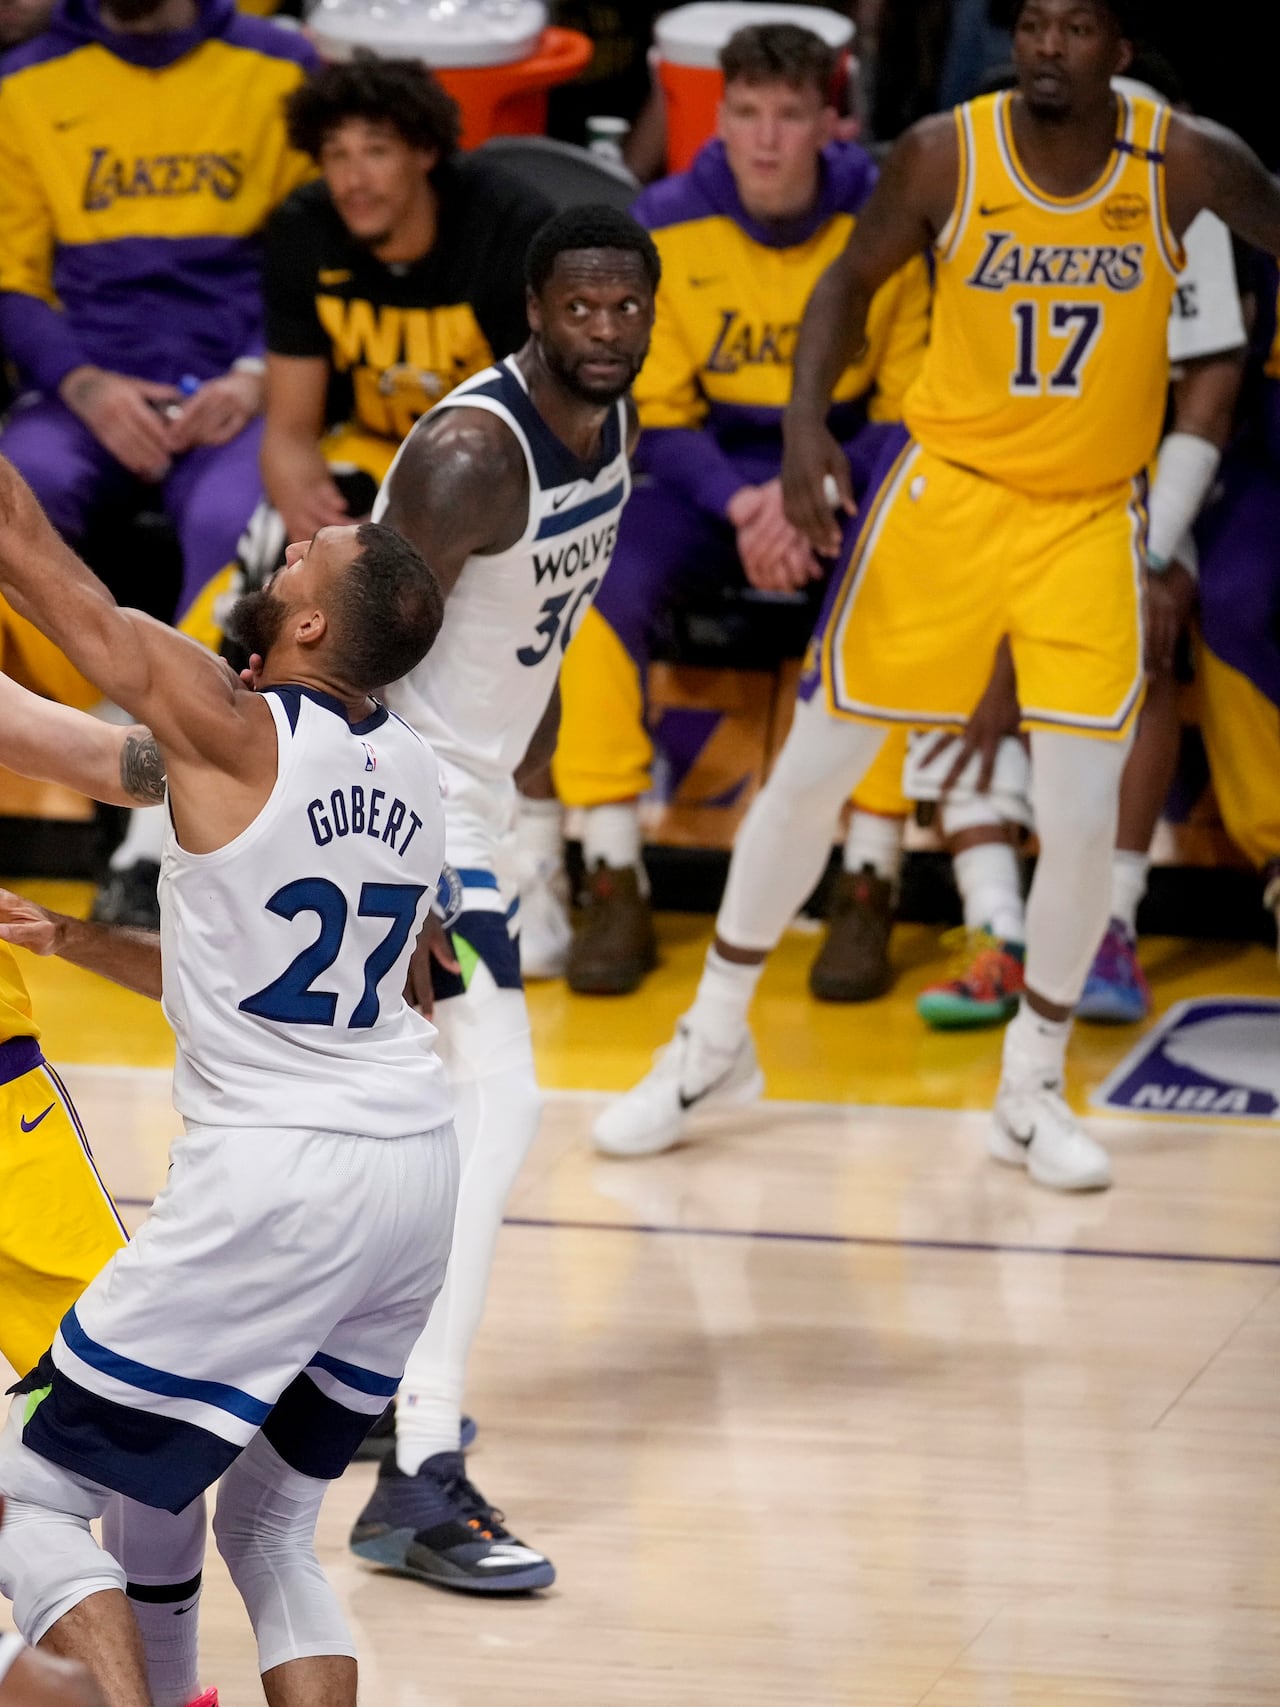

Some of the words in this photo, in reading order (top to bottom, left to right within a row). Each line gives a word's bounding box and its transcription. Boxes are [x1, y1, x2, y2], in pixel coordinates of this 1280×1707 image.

[81, 148, 244, 214] LAKERS
[967, 232, 1144, 292] LAKERS
[1011, 301, 1104, 397] 17
[307, 785, 423, 857] GOBERT
[238, 877, 428, 1028] 27
[1130, 1083, 1252, 1112] NBA
